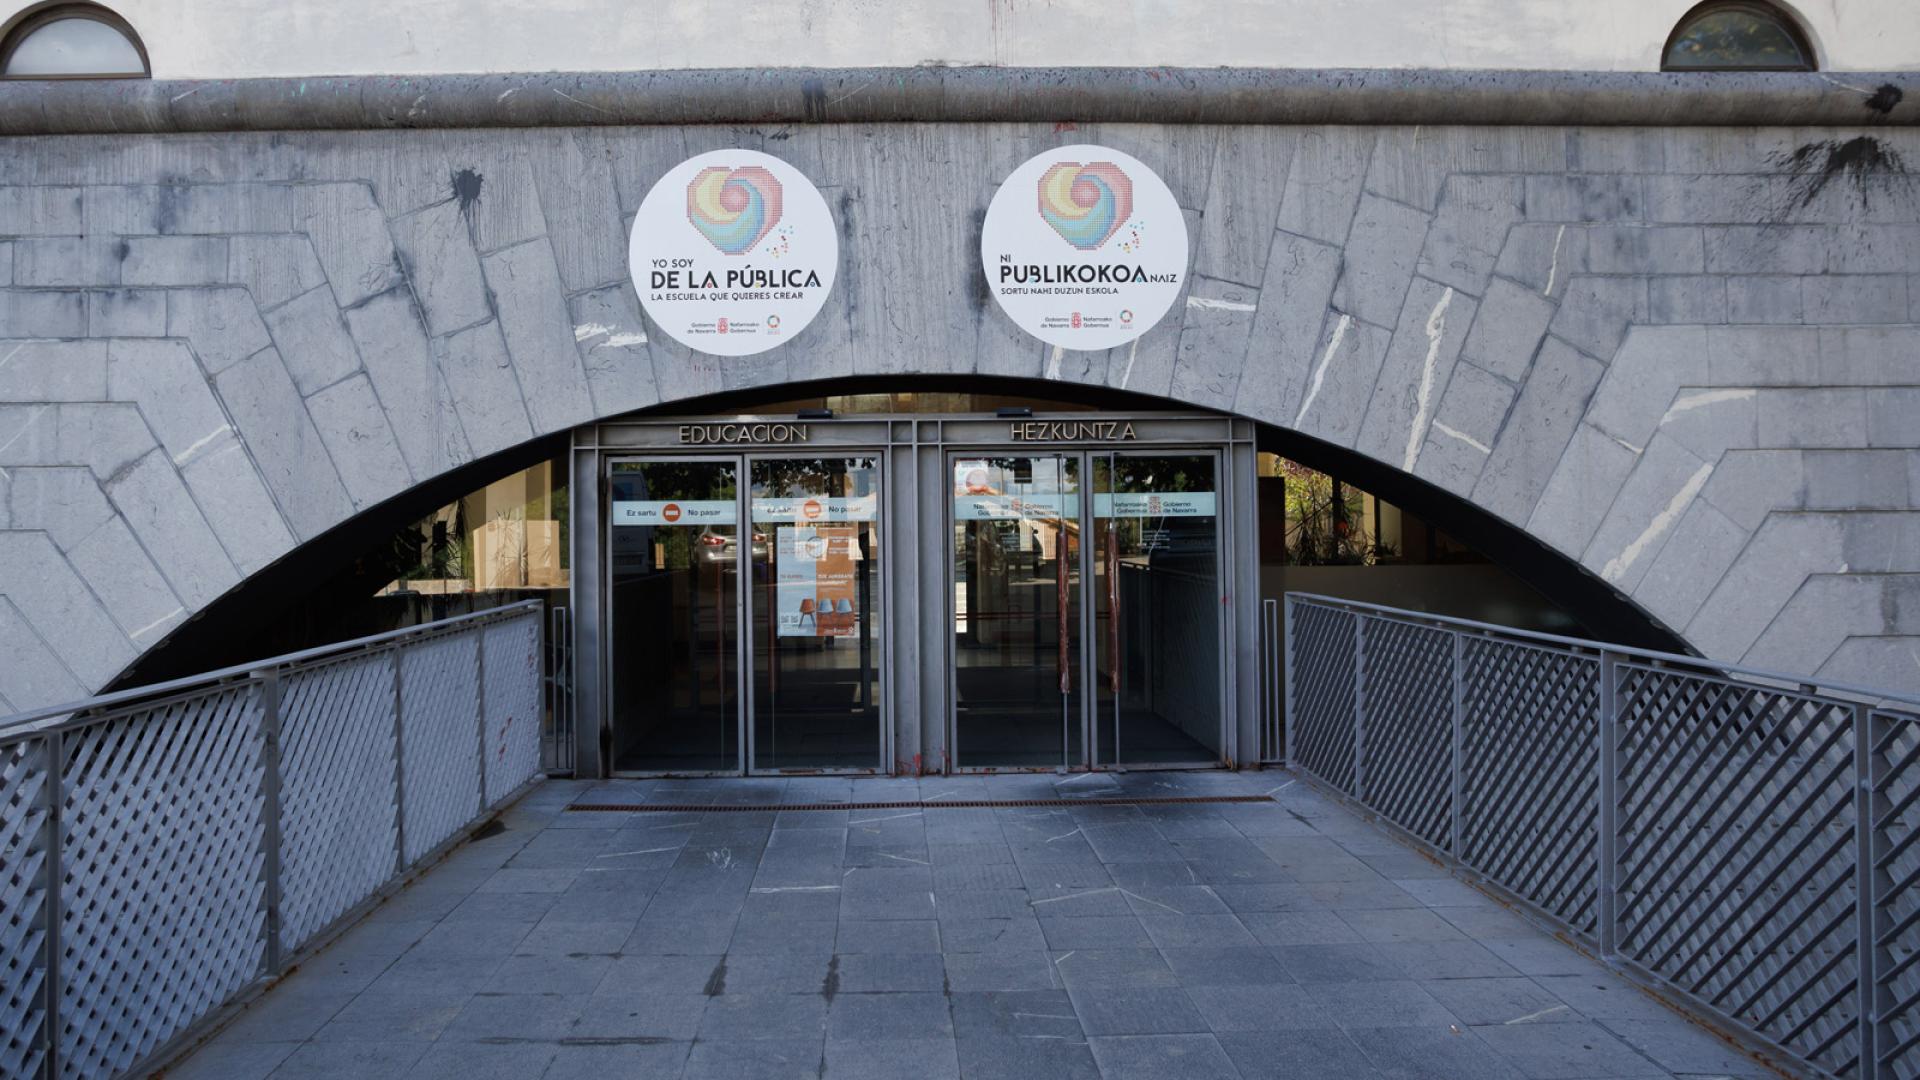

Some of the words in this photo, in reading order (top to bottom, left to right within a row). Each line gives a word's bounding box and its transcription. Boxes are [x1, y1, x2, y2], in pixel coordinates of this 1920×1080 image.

[652, 259, 668, 268] YO
[672, 258, 694, 268] SOY
[1000, 254, 1011, 263] NI
[651, 271, 680, 289] DE
[689, 270, 719, 289] LA
[727, 264, 822, 289] PÚBLICA
[1000, 264, 1148, 284] PUBLIKOKOA
[1150, 274, 1177, 283] NAIZ
[1031, 287, 1052, 295] NAHI
[1054, 287, 1084, 295] DUZUN
[1085, 287, 1119, 295] ESKOLA
[651, 293, 662, 301] LA
[666, 292, 707, 301] ESCUELA
[710, 292, 729, 302] QUE
[731, 292, 771, 301] QUIERES
[773, 291, 804, 300] CREAR
[679, 424, 807, 444] EDUCACION
[1011, 422, 1137, 440] HEZKUNTZA
[637, 509, 657, 517] sartu
[700, 509, 721, 517] pasar
[829, 505, 840, 513] No
